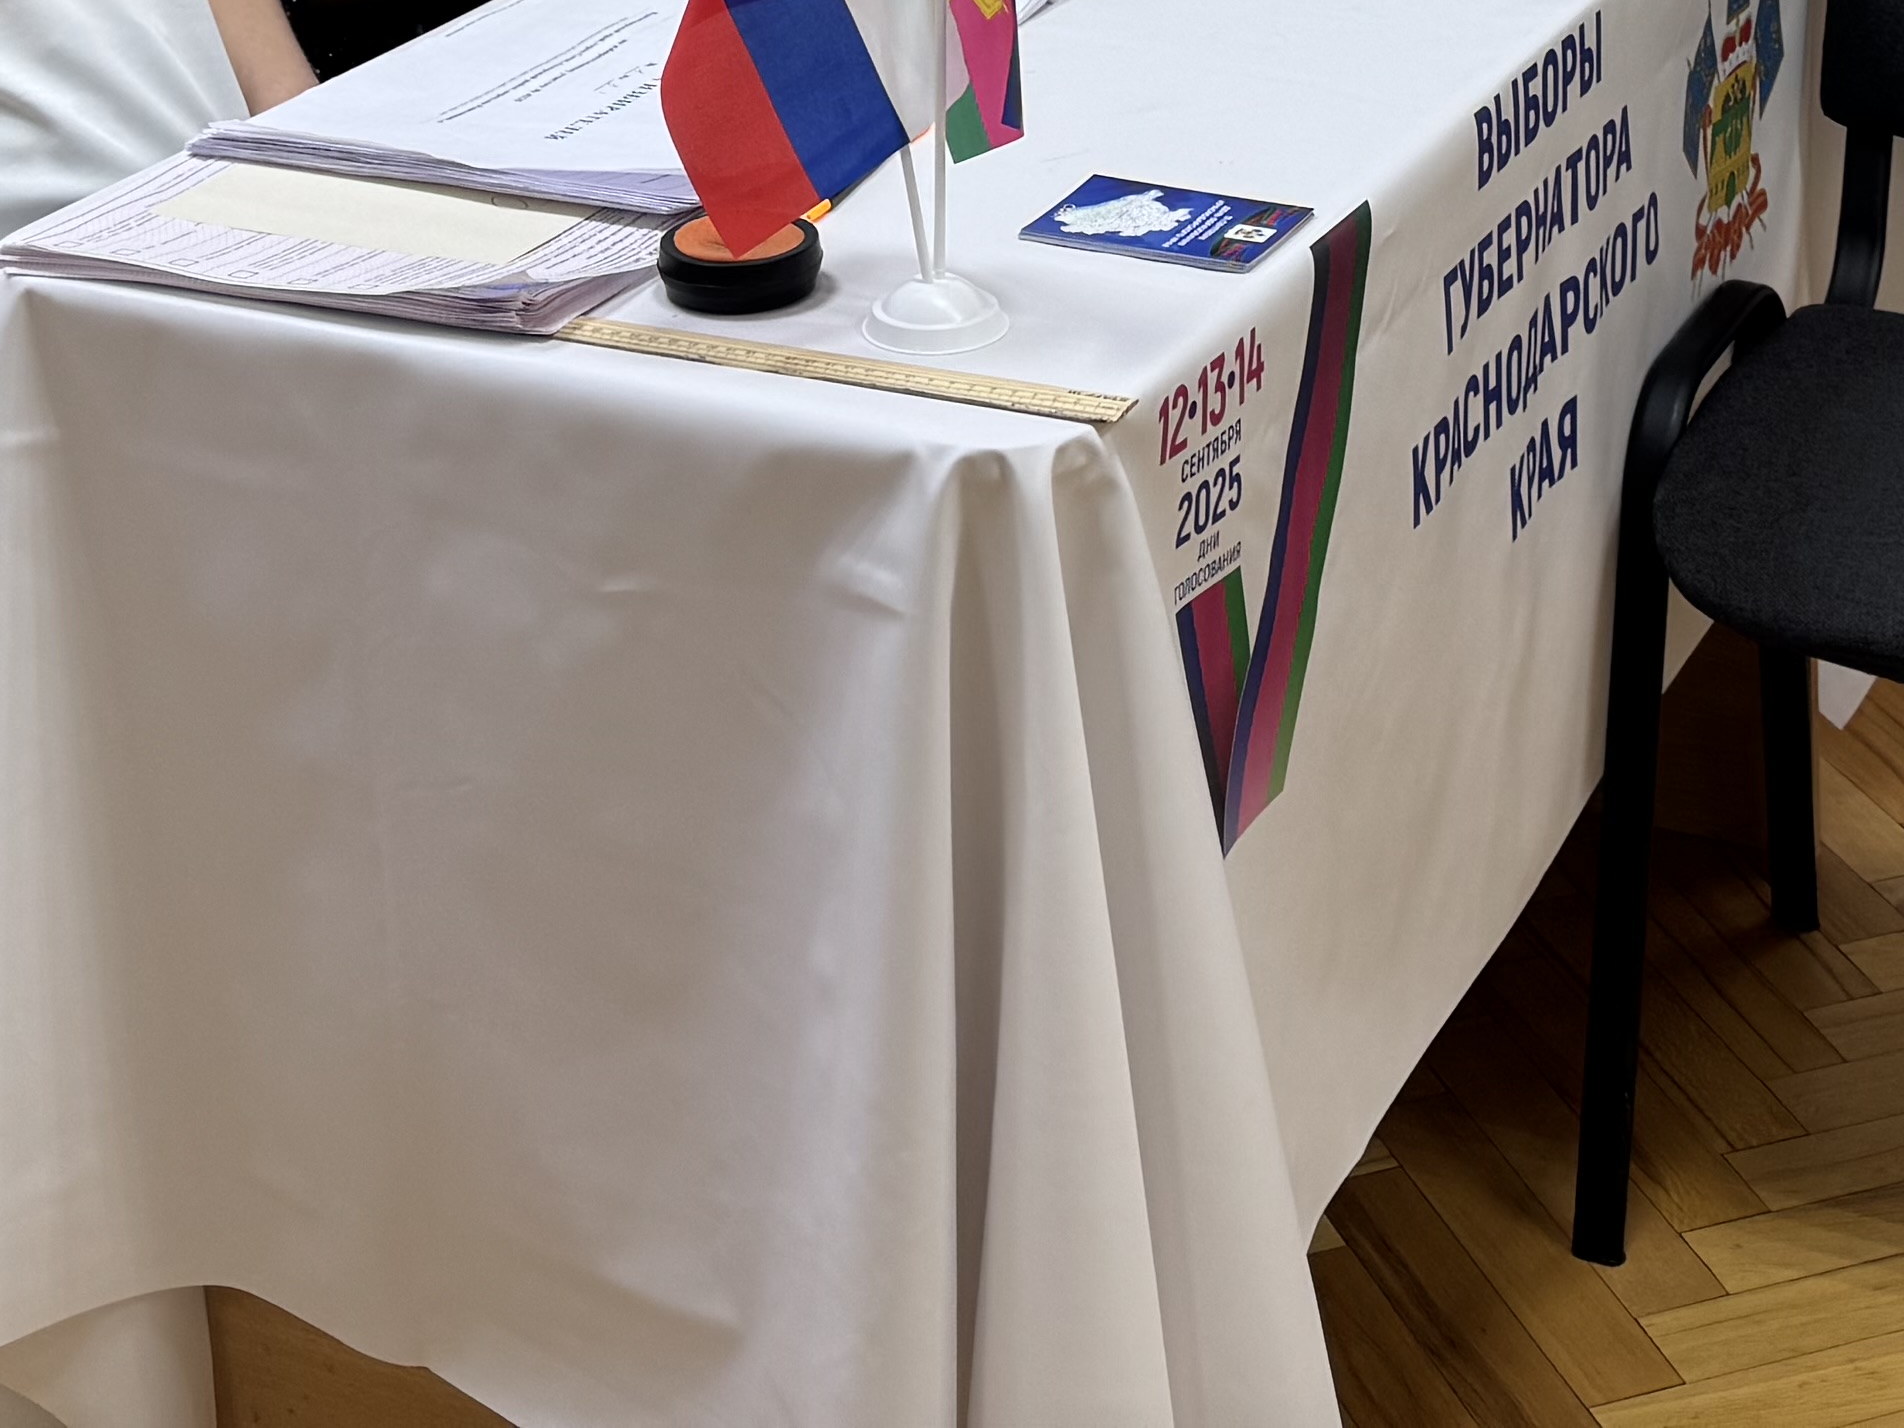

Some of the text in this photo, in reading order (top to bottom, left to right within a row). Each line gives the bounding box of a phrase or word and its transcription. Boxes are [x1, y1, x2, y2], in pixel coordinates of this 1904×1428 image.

[1474, 9, 1602, 191] ВЫБОРЫ
[1444, 104, 1632, 356] ГУБЕРНАТОРА
[1412, 192, 1660, 530] КРАСНОДАРСКОГО
[1175, 454, 1243, 550] 2025
[1181, 417, 1242, 483] СЕНТЯБРЯ
[1510, 394, 1578, 543] КРАЯ
[1173, 541, 1242, 606] ГОЛОСОВАНИЯ
[1197, 530, 1220, 562] ДНИ
